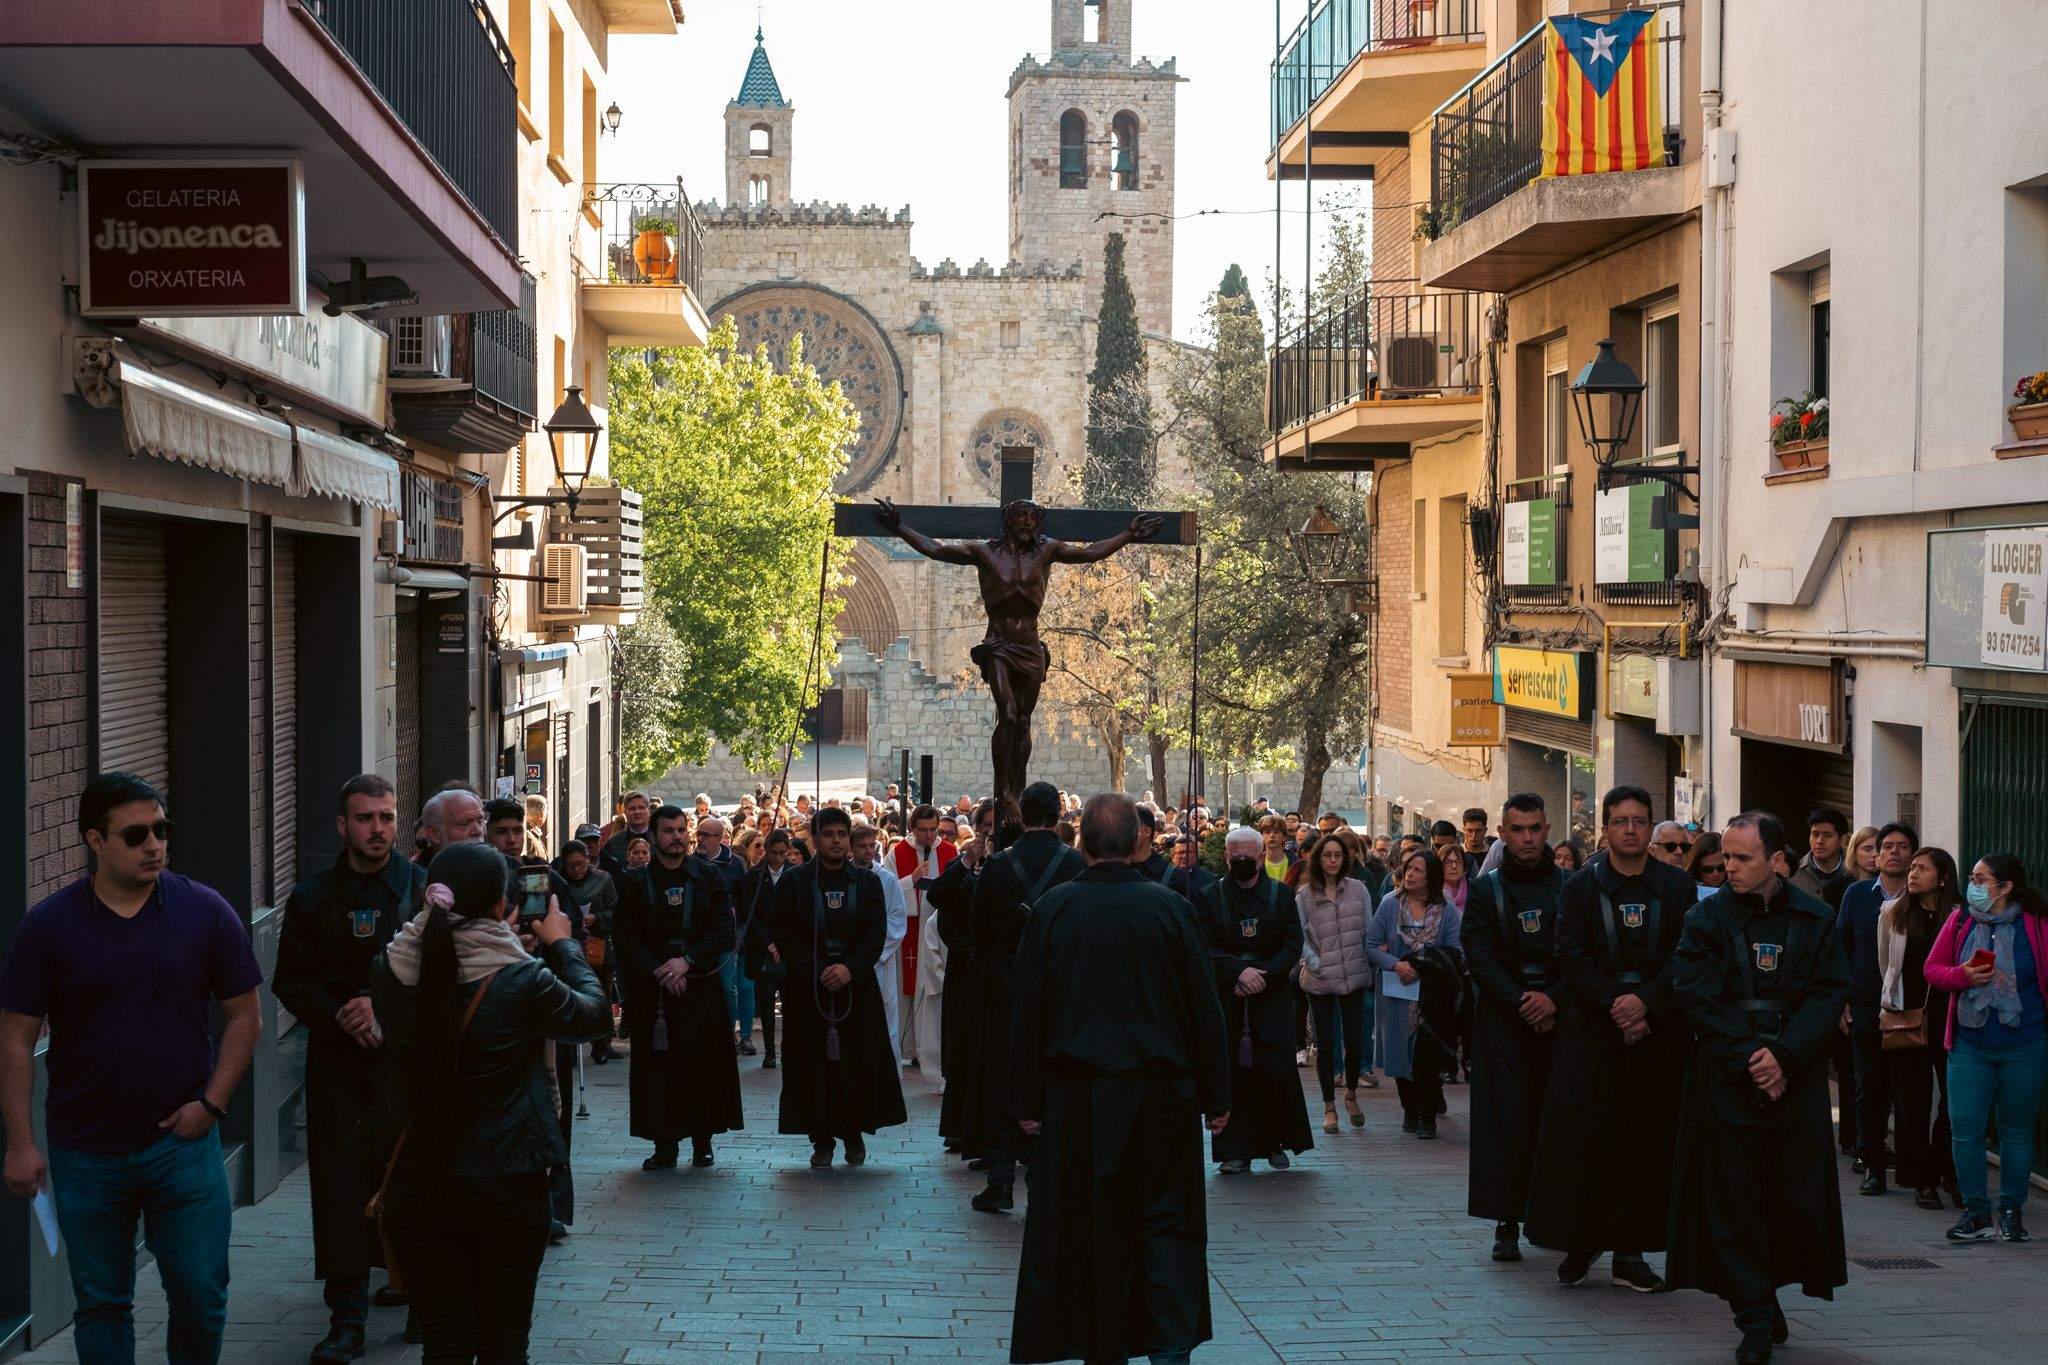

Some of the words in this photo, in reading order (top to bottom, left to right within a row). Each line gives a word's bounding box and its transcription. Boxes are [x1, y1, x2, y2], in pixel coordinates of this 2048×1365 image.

[127, 189, 241, 207] GELATERIA
[96, 218, 282, 254] Jijonenca
[129, 270, 245, 288] ORXATERIA
[1991, 543, 2041, 574] LLOGUER
[1986, 631, 1998, 653] 93
[2000, 633, 2041, 656] 6747254
